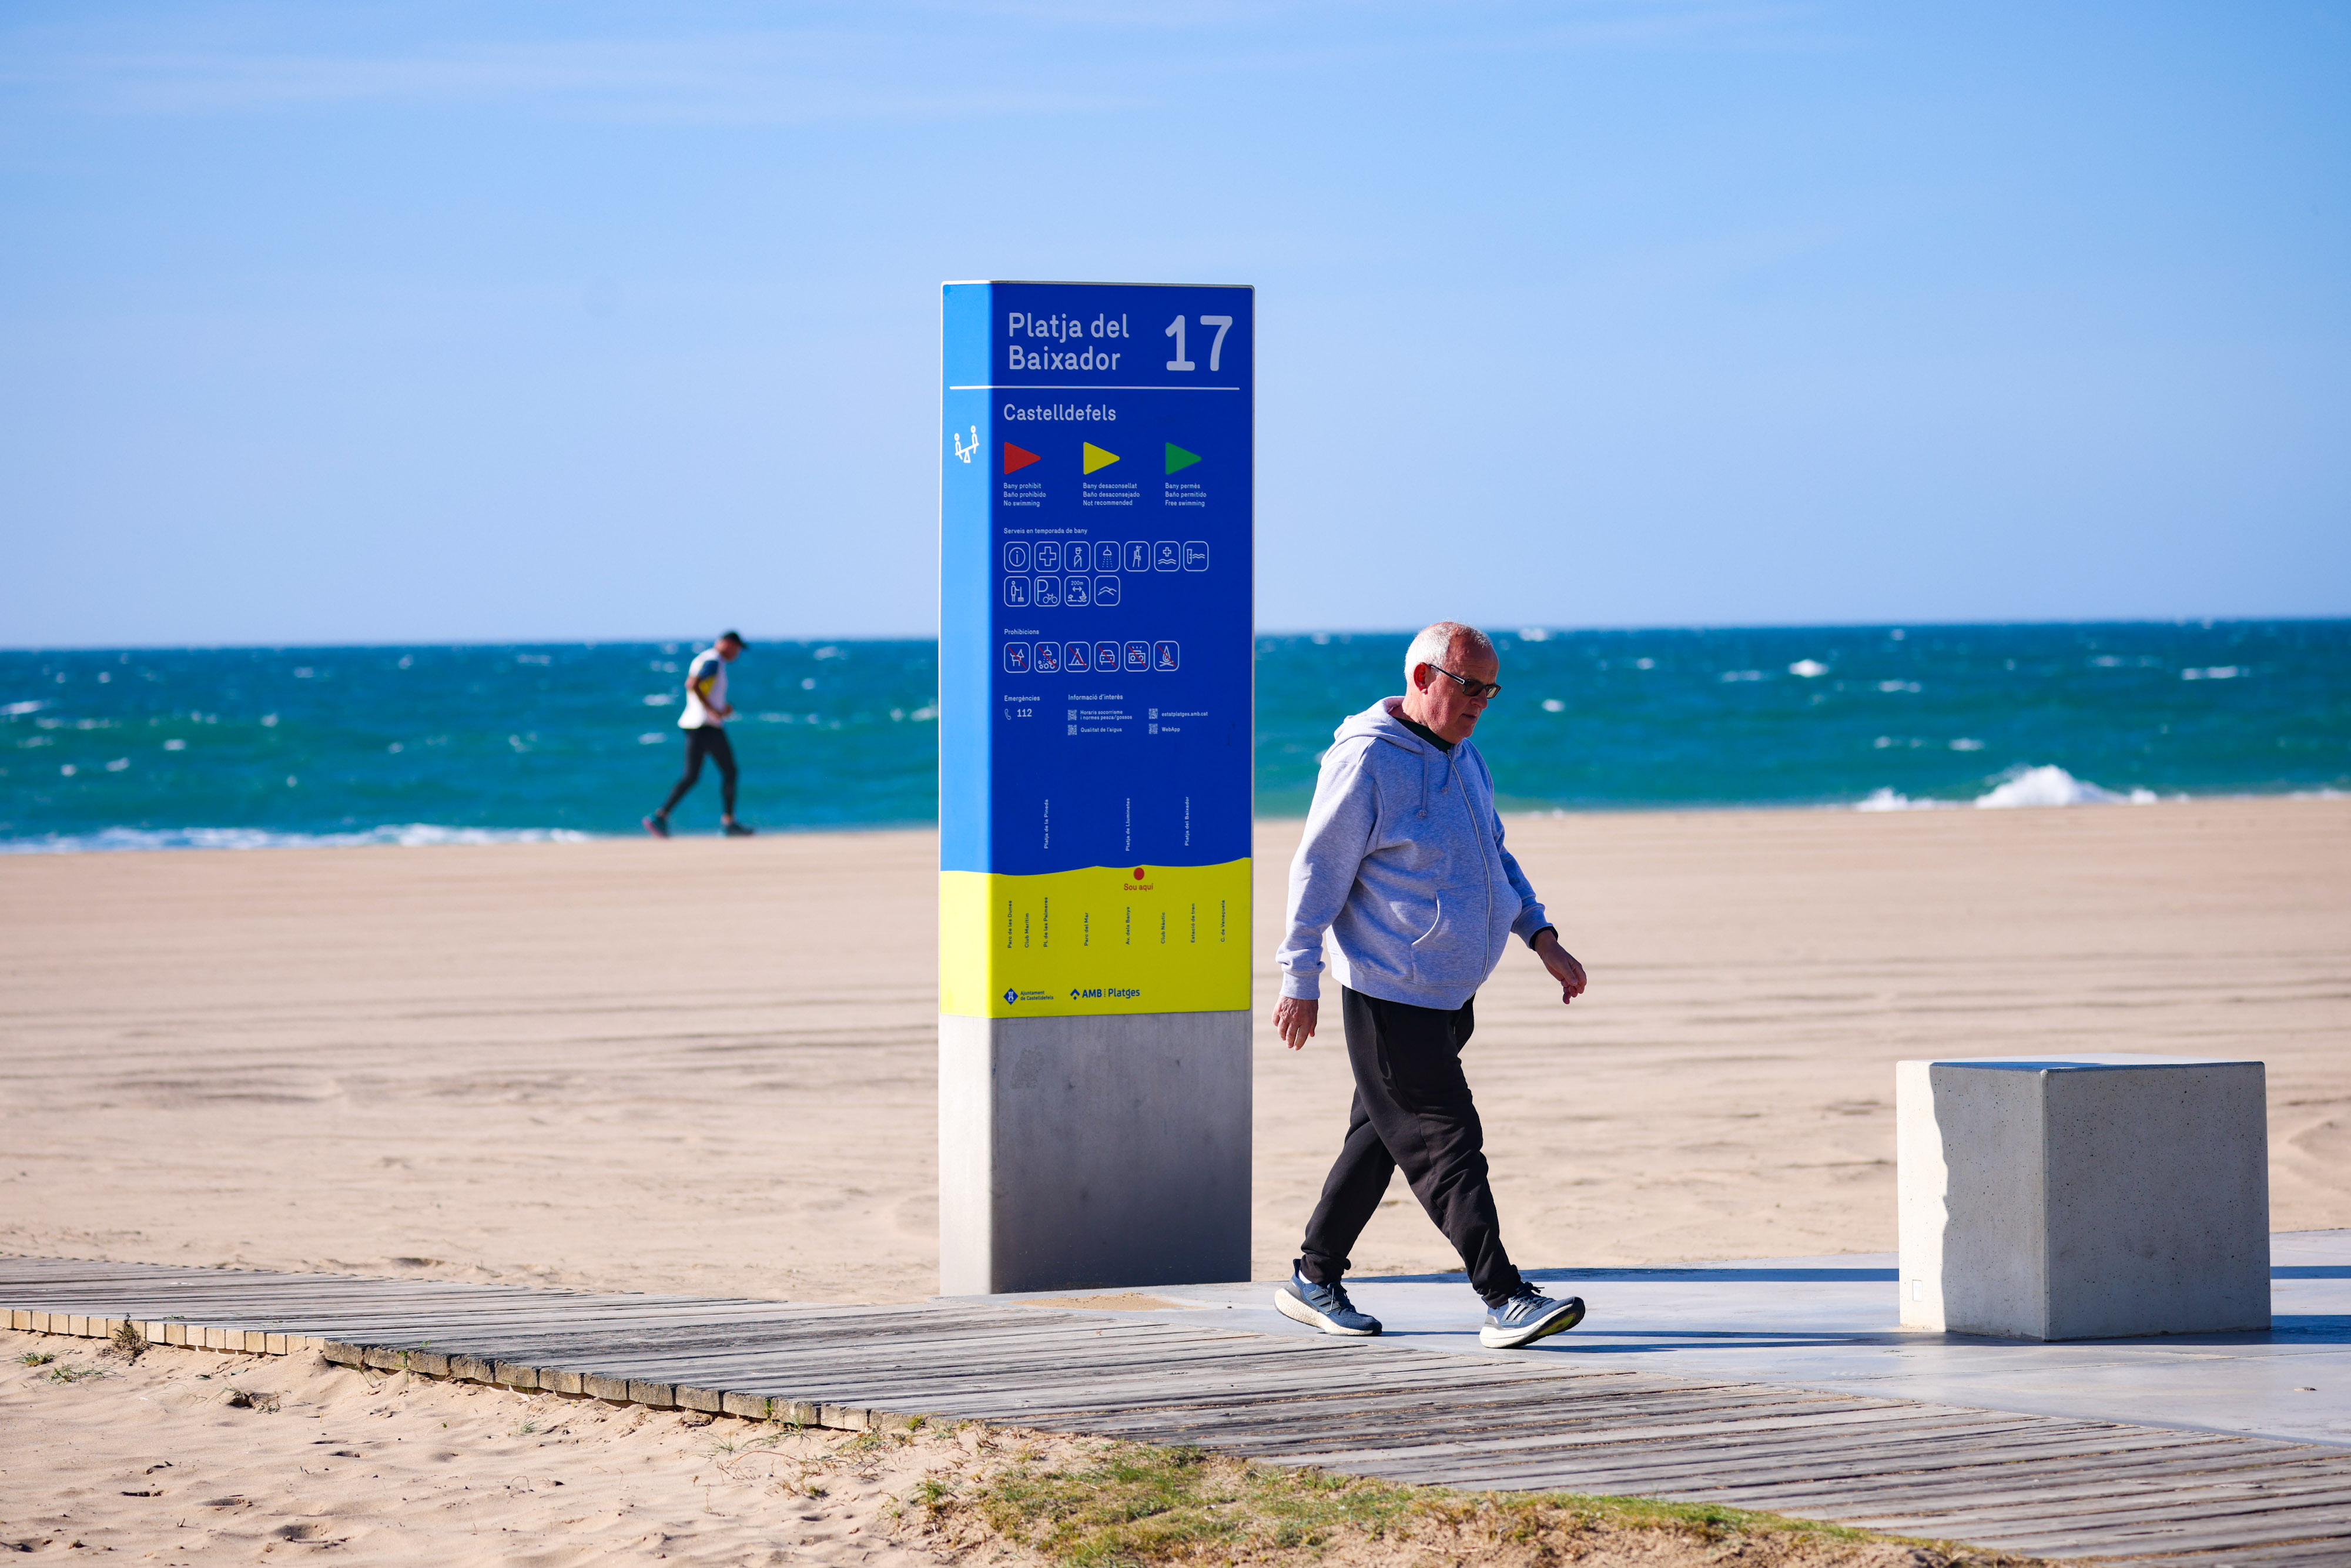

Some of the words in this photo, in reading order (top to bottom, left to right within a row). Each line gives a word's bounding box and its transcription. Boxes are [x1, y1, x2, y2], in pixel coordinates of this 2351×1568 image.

[1009, 313, 1083, 343] Platja
[1091, 313, 1129, 338] del
[1165, 315, 1233, 371] 17
[1009, 346, 1120, 370] Baixador
[1004, 404, 1116, 421] Castelldefels
[1017, 709, 1032, 717] 112
[1139, 883, 1153, 892] aquí
[1082, 989, 1102, 998] AMB
[1108, 987, 1140, 999] Platges
